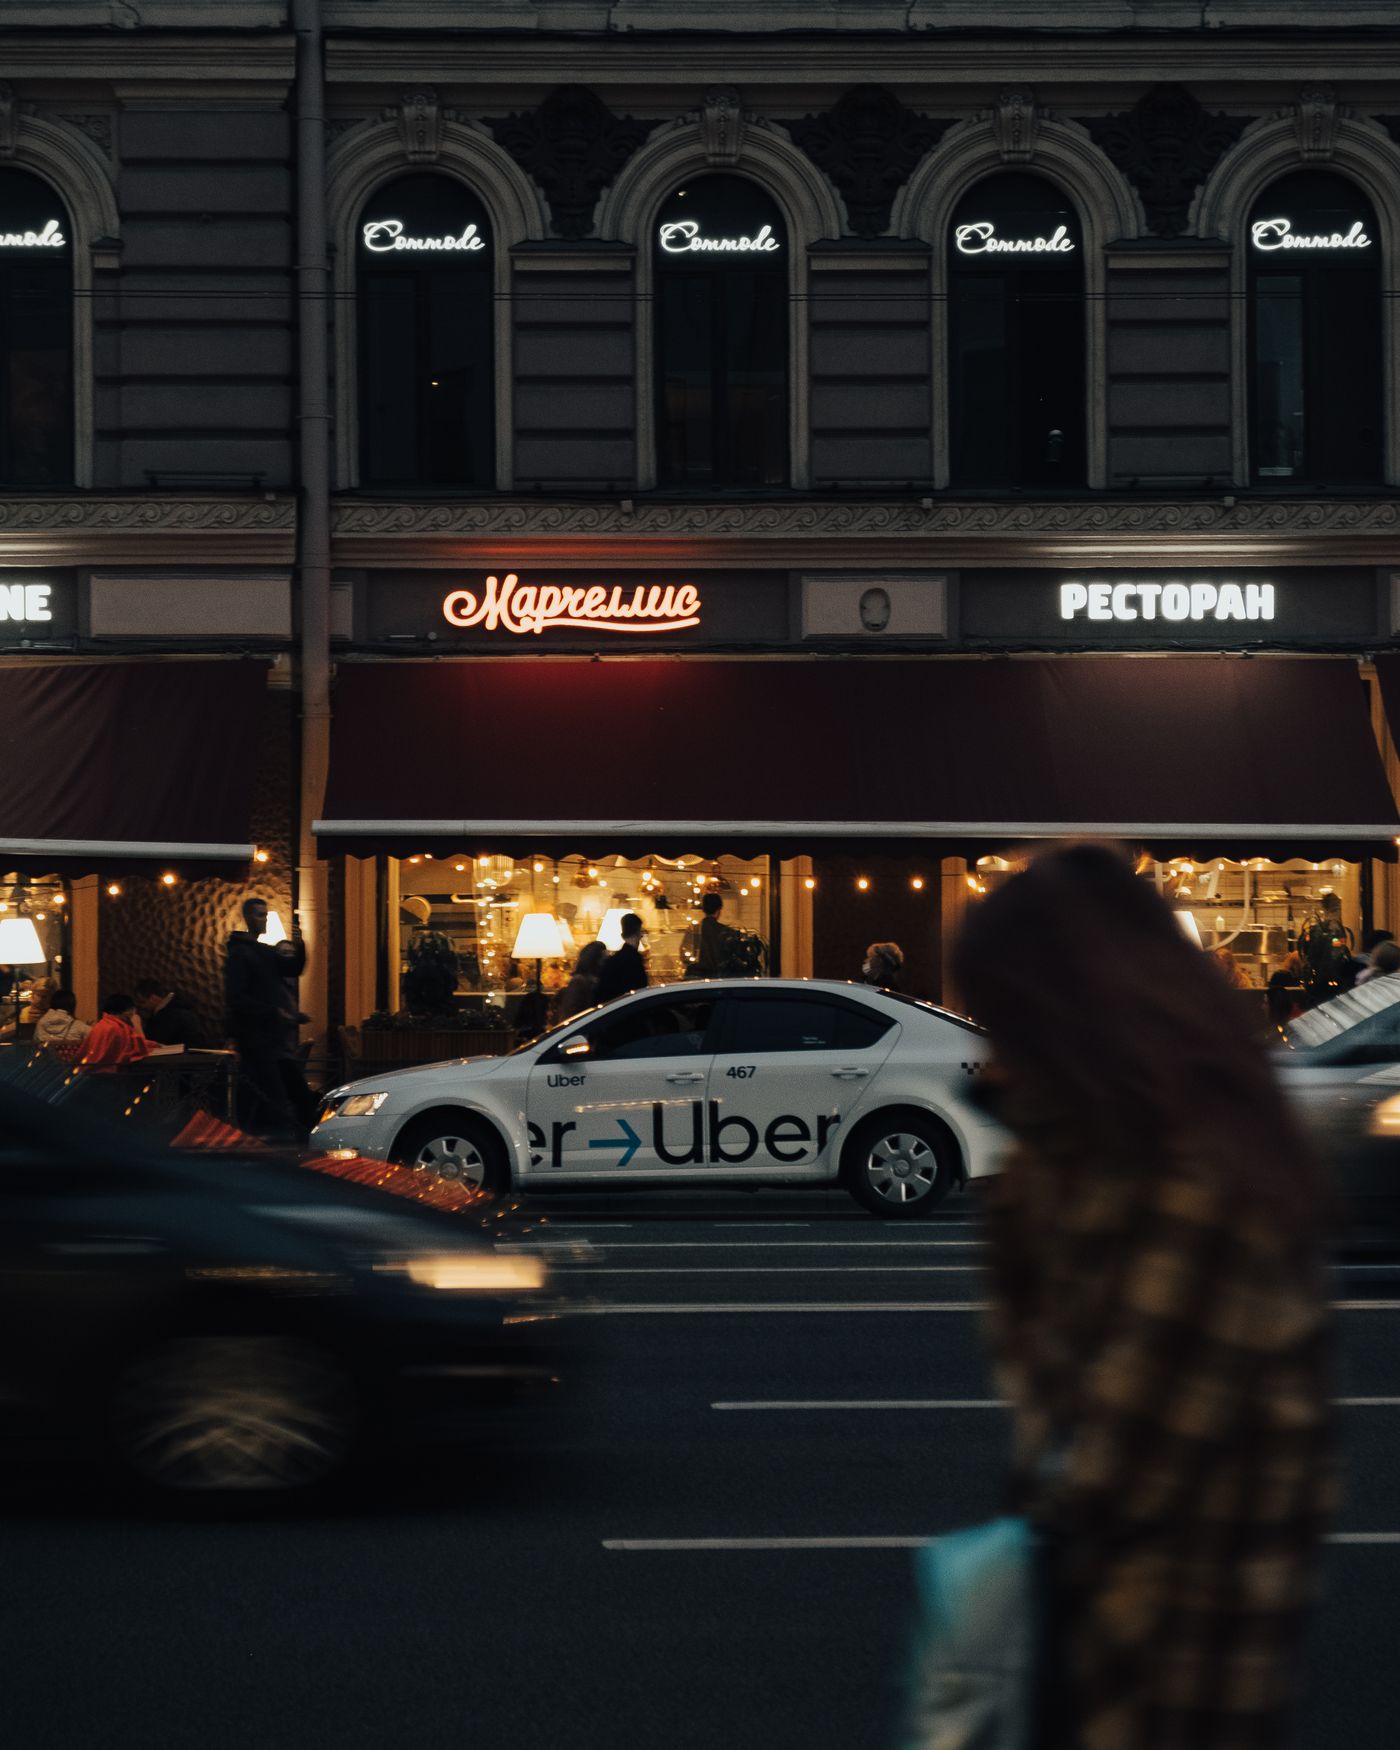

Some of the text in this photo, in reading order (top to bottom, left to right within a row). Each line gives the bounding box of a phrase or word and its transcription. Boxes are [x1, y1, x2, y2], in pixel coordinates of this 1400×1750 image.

[0, 219, 66, 247] mode
[363, 219, 485, 252] Commode
[660, 220, 780, 253] Commode
[956, 222, 1075, 254] Commode
[1252, 218, 1372, 251] Commode
[1060, 582, 1275, 621] РЕСТОРАН
[547, 1074, 586, 1088] Uber
[726, 1065, 757, 1080] 467
[652, 1100, 841, 1165] Uber
